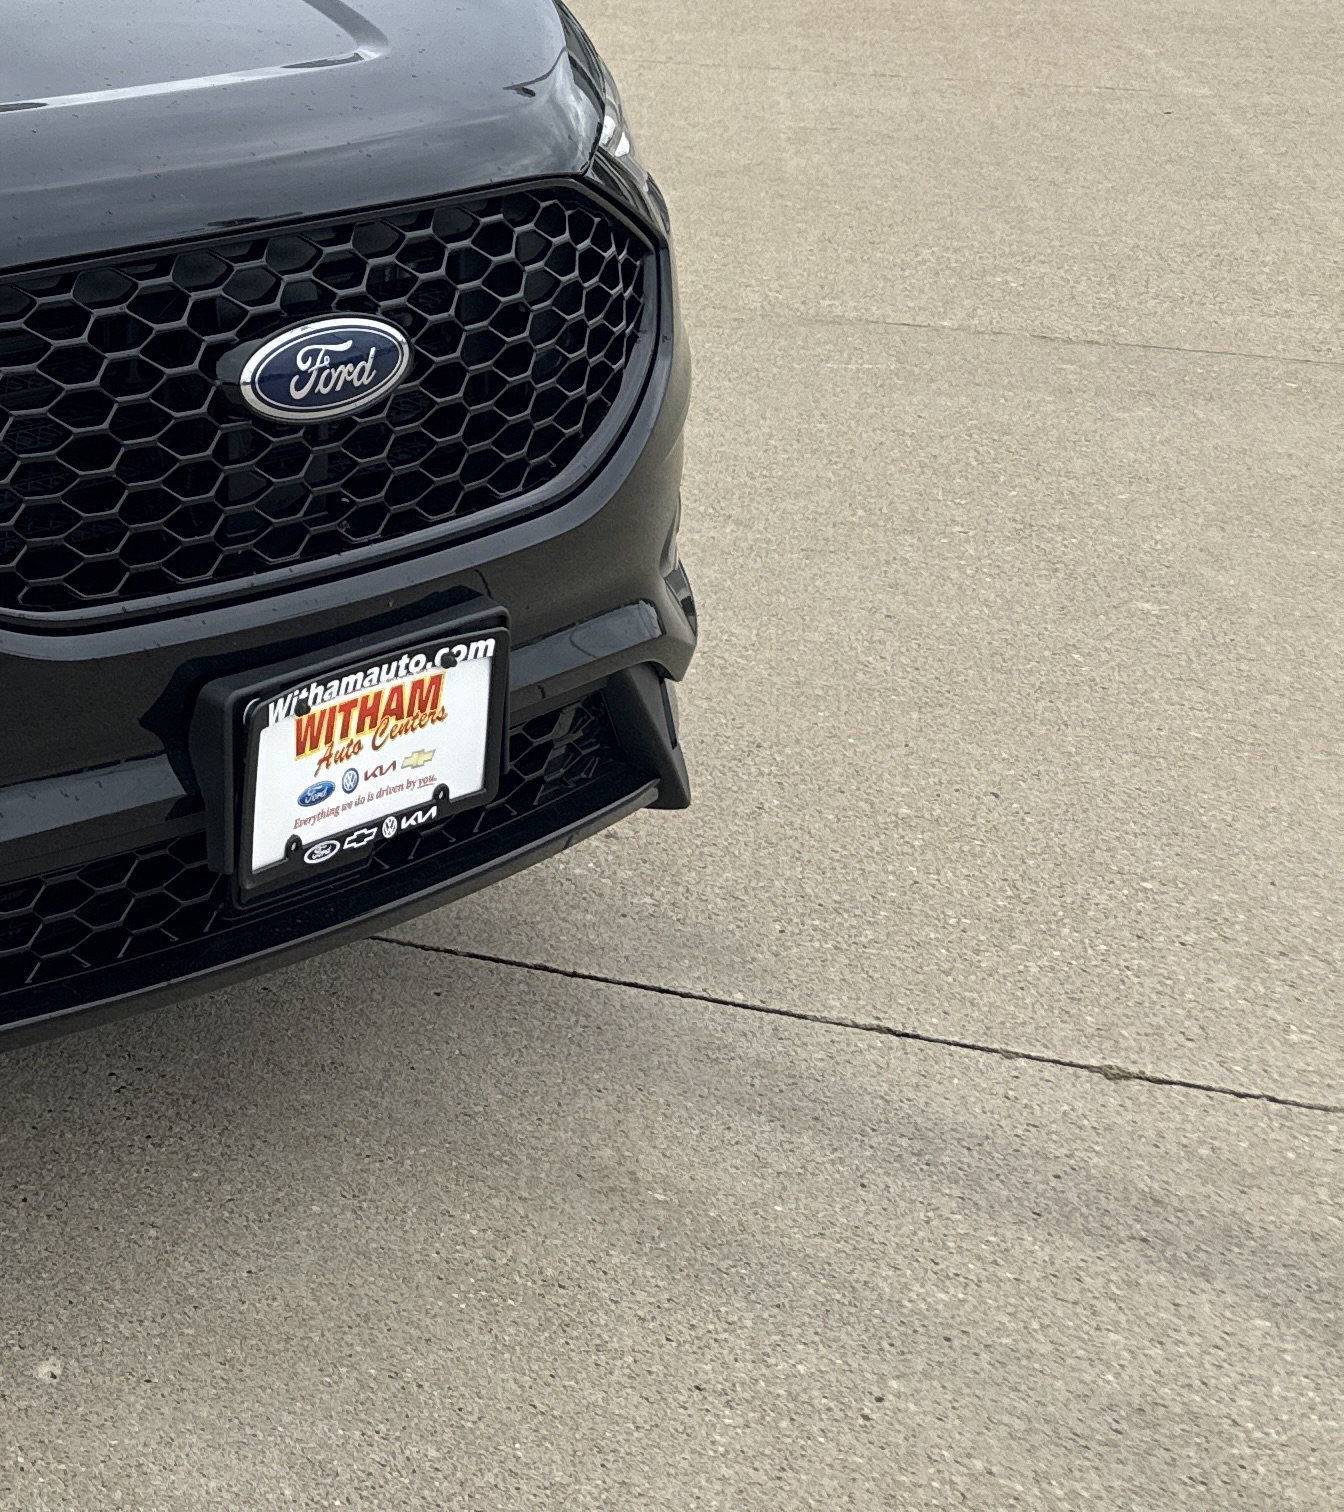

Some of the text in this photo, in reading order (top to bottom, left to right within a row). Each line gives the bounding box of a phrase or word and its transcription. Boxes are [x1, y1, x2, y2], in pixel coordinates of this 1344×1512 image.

[290, 339, 377, 399] Ford
[294, 671, 446, 759] WITHAM
[314, 705, 448, 777] Auto Centers
[293, 805, 340, 829] Everything
[341, 799, 353, 812] we
[354, 794, 366, 807] do
[367, 791, 375, 803] is
[376, 783, 404, 800] driven
[405, 778, 417, 791] by
